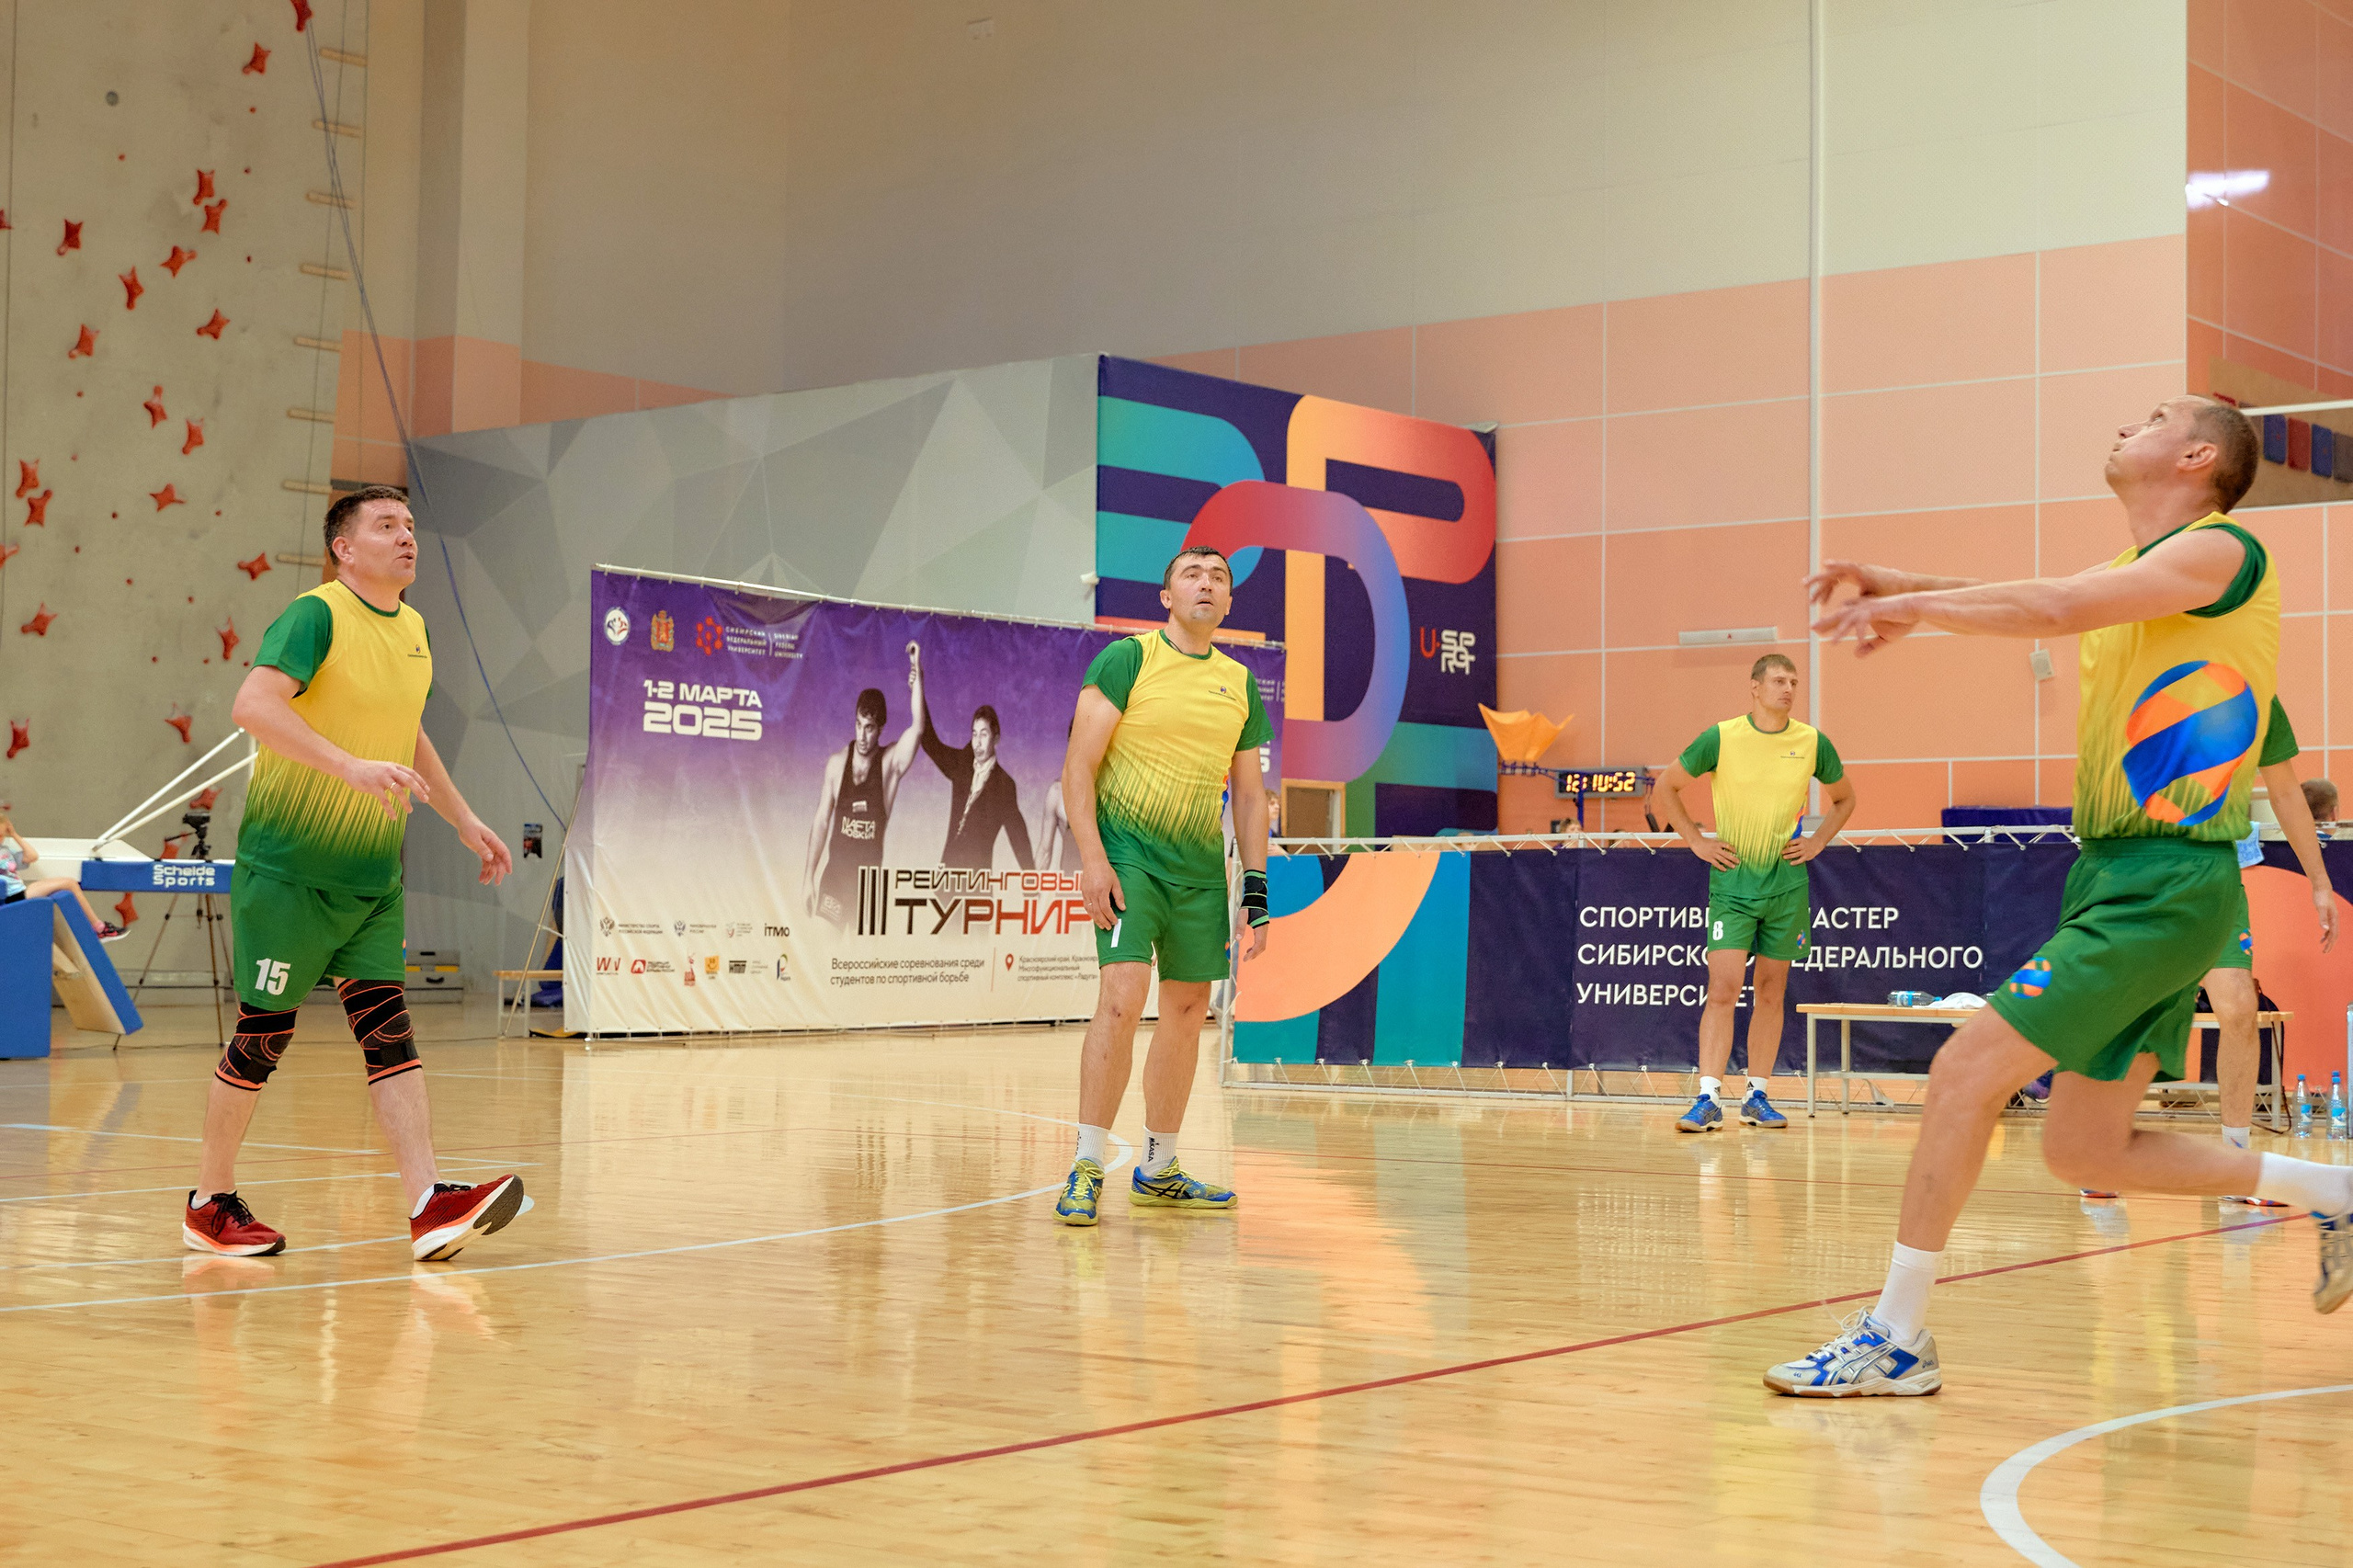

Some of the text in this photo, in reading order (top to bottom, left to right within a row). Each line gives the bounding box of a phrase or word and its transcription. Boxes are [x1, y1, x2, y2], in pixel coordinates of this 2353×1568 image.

[643, 679, 763, 709] 1-2 МАРТА
[643, 700, 763, 742] 2025
[153, 874, 216, 888] Sports
[894, 866, 1083, 892] РЕЙТИНГОВЫ
[894, 899, 1092, 935] ТУРНИР
[1579, 906, 1899, 929] СПОРТИВ АСТЕР
[1712, 920, 1724, 941] 8
[831, 958, 984, 972] Всероссийские соревнования среди
[1577, 944, 1984, 972] СИБИРСК ДЕРАЛЬНОГО
[256, 958, 291, 995] 15
[830, 971, 970, 987] студентов по спортивной борьбе
